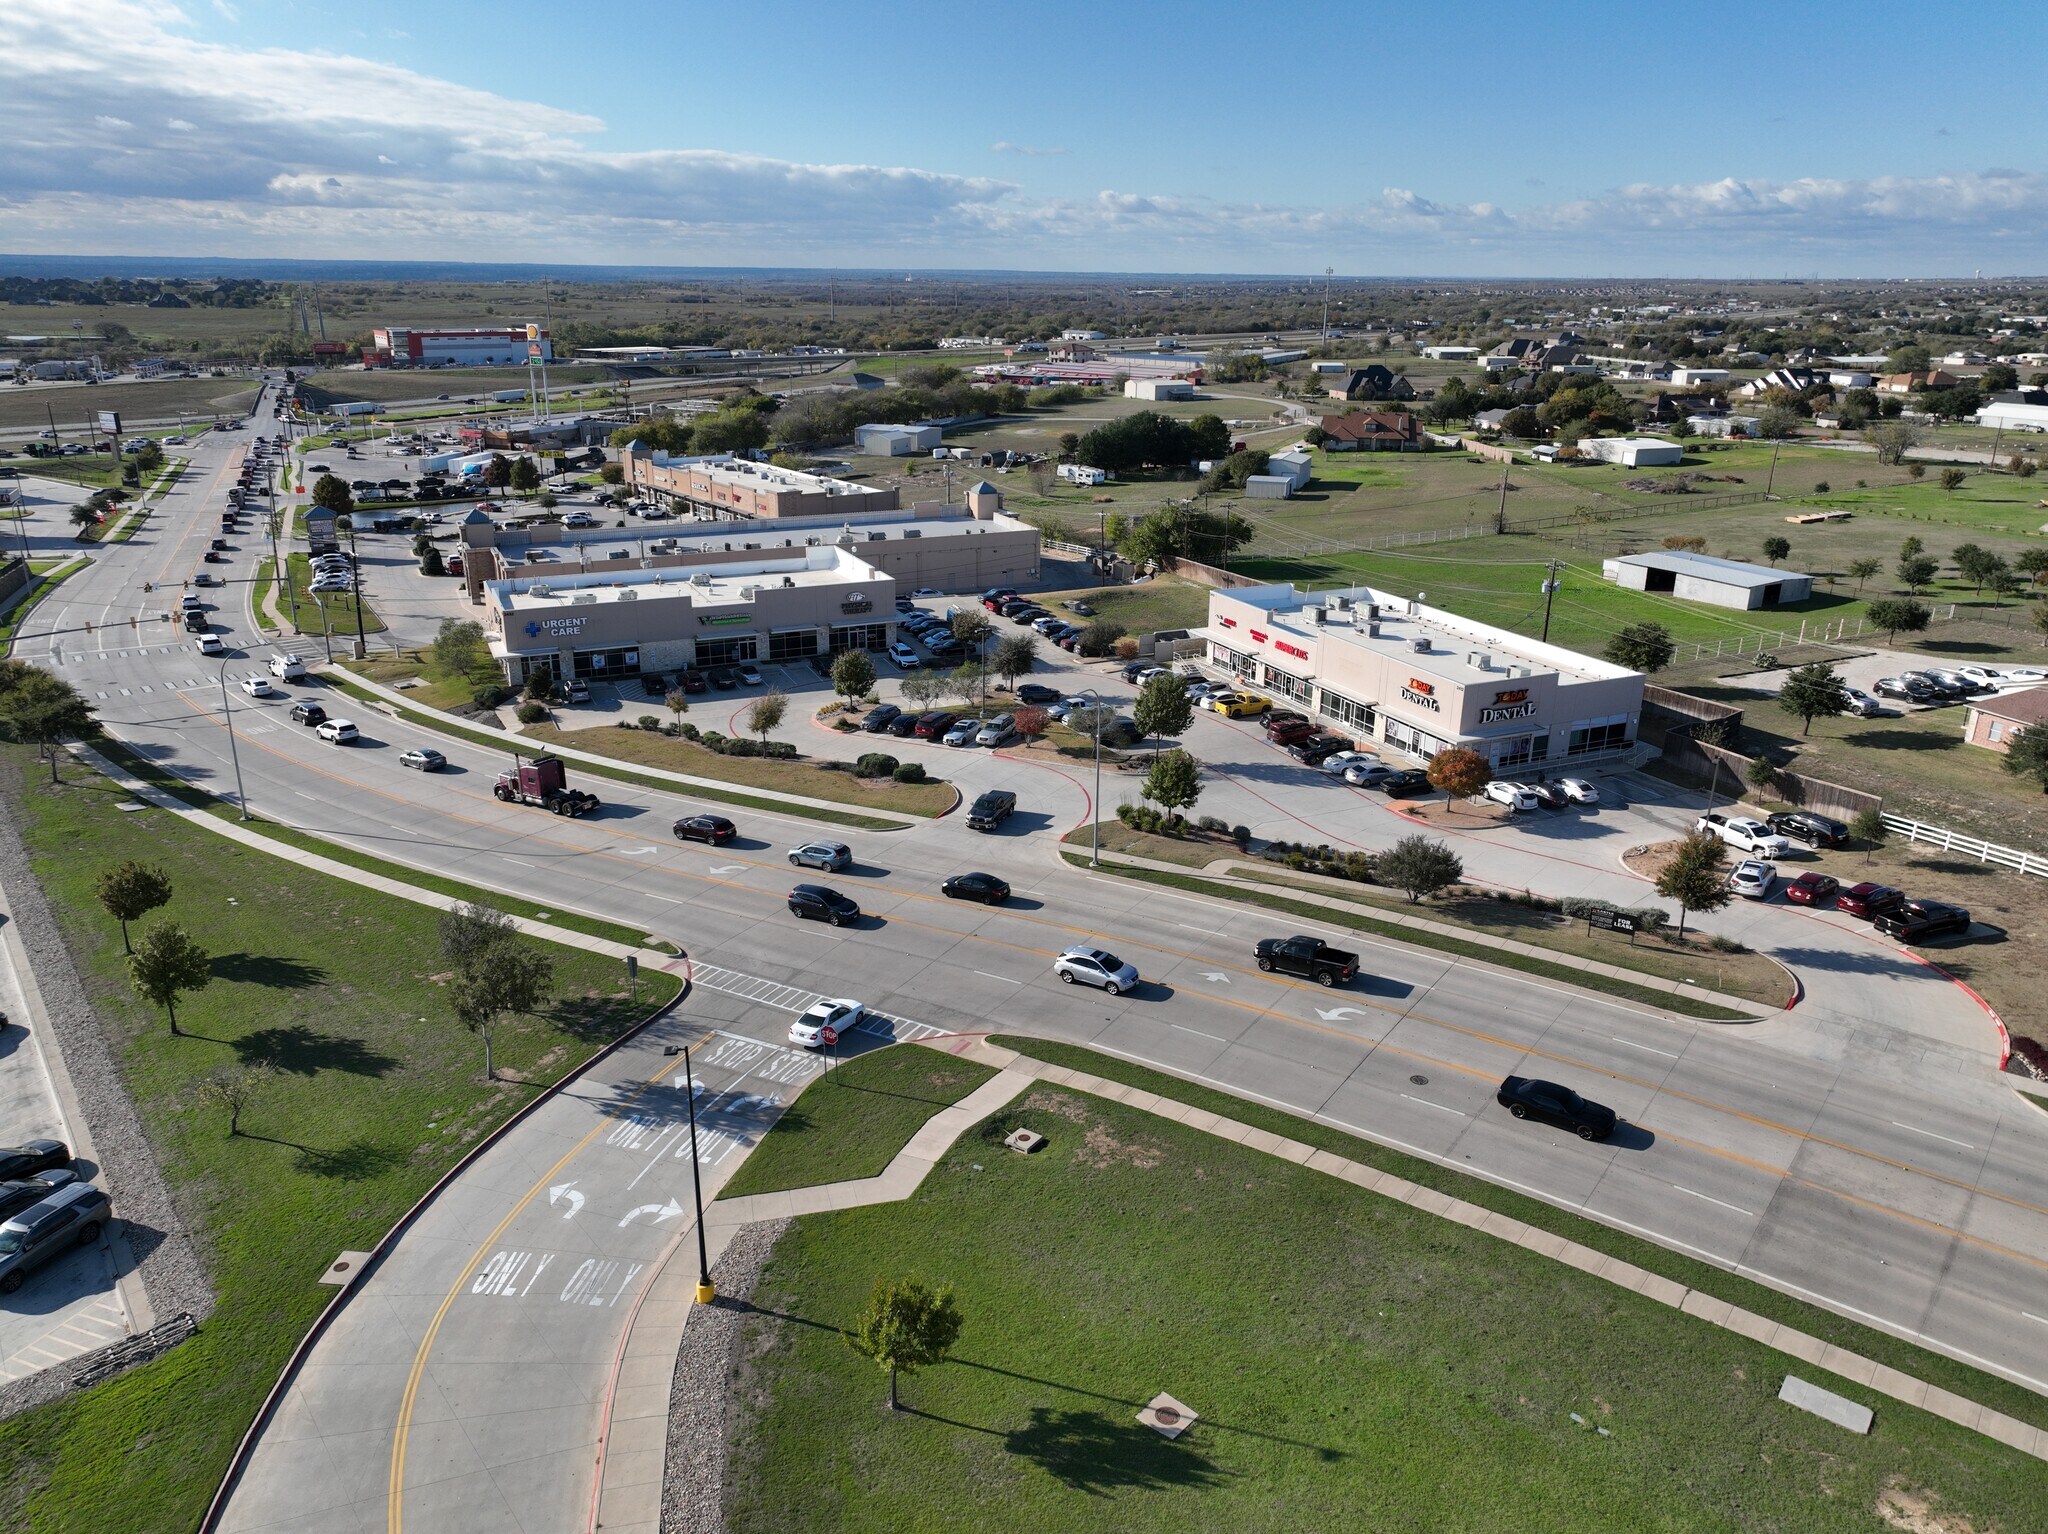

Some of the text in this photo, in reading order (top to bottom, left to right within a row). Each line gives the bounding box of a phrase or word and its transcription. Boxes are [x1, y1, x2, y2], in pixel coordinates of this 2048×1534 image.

[542, 617, 587, 629] URGENT
[550, 626, 581, 637] CARE
[1409, 678, 1432, 694] TODAY
[1497, 690, 1529, 702] TODAY
[1400, 687, 1437, 711] DENTAL
[1481, 702, 1537, 724] DENTAL
[1613, 921, 1634, 930] LEASE
[821, 1030, 837, 1039] STOP
[704, 1039, 763, 1069] STOP
[759, 1053, 819, 1085] STOP
[606, 1114, 679, 1152] ONLY
[674, 1127, 748, 1166] ONLY
[471, 1250, 556, 1297] ONLY
[560, 1258, 644, 1308] ONLY
